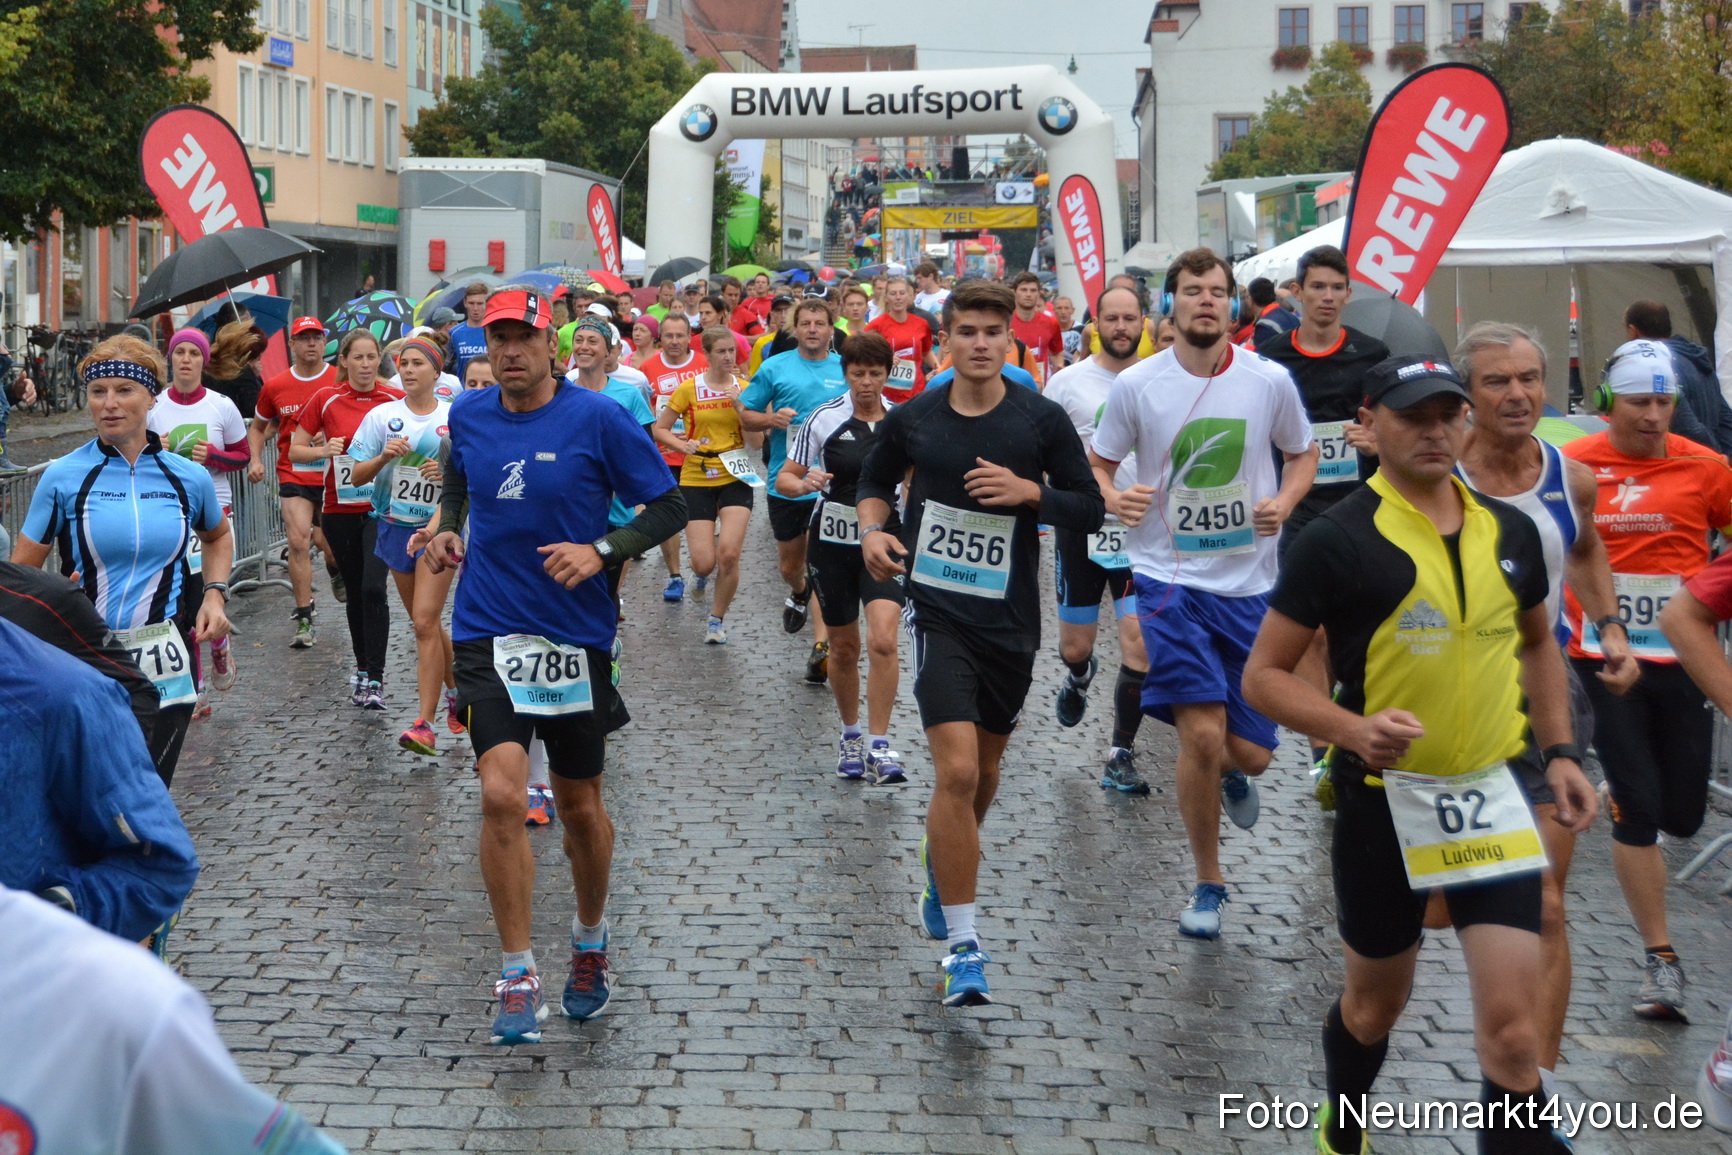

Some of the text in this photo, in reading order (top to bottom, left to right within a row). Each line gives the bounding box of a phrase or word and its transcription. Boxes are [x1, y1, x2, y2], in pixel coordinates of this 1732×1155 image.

[731, 83, 1023, 120] BMW Laufsport
[1355, 96, 1486, 297] REWE
[943, 211, 978, 224] ZIEL
[890, 366, 913, 380] 078
[697, 402, 719, 411] MAX
[409, 506, 429, 517] Katja
[1177, 500, 1246, 531] 2450
[963, 513, 1009, 530] BOCK
[1609, 521, 1674, 533] neumarkt
[927, 524, 1006, 567] 2556
[1199, 538, 1228, 549] Marc
[942, 565, 978, 584] David
[1395, 632, 1452, 646] Pyraser
[1410, 643, 1441, 655] Bier
[505, 651, 581, 683] 2786
[527, 690, 564, 703] Dieter
[1434, 789, 1492, 834] 62
[1441, 843, 1505, 867] Ludwig
